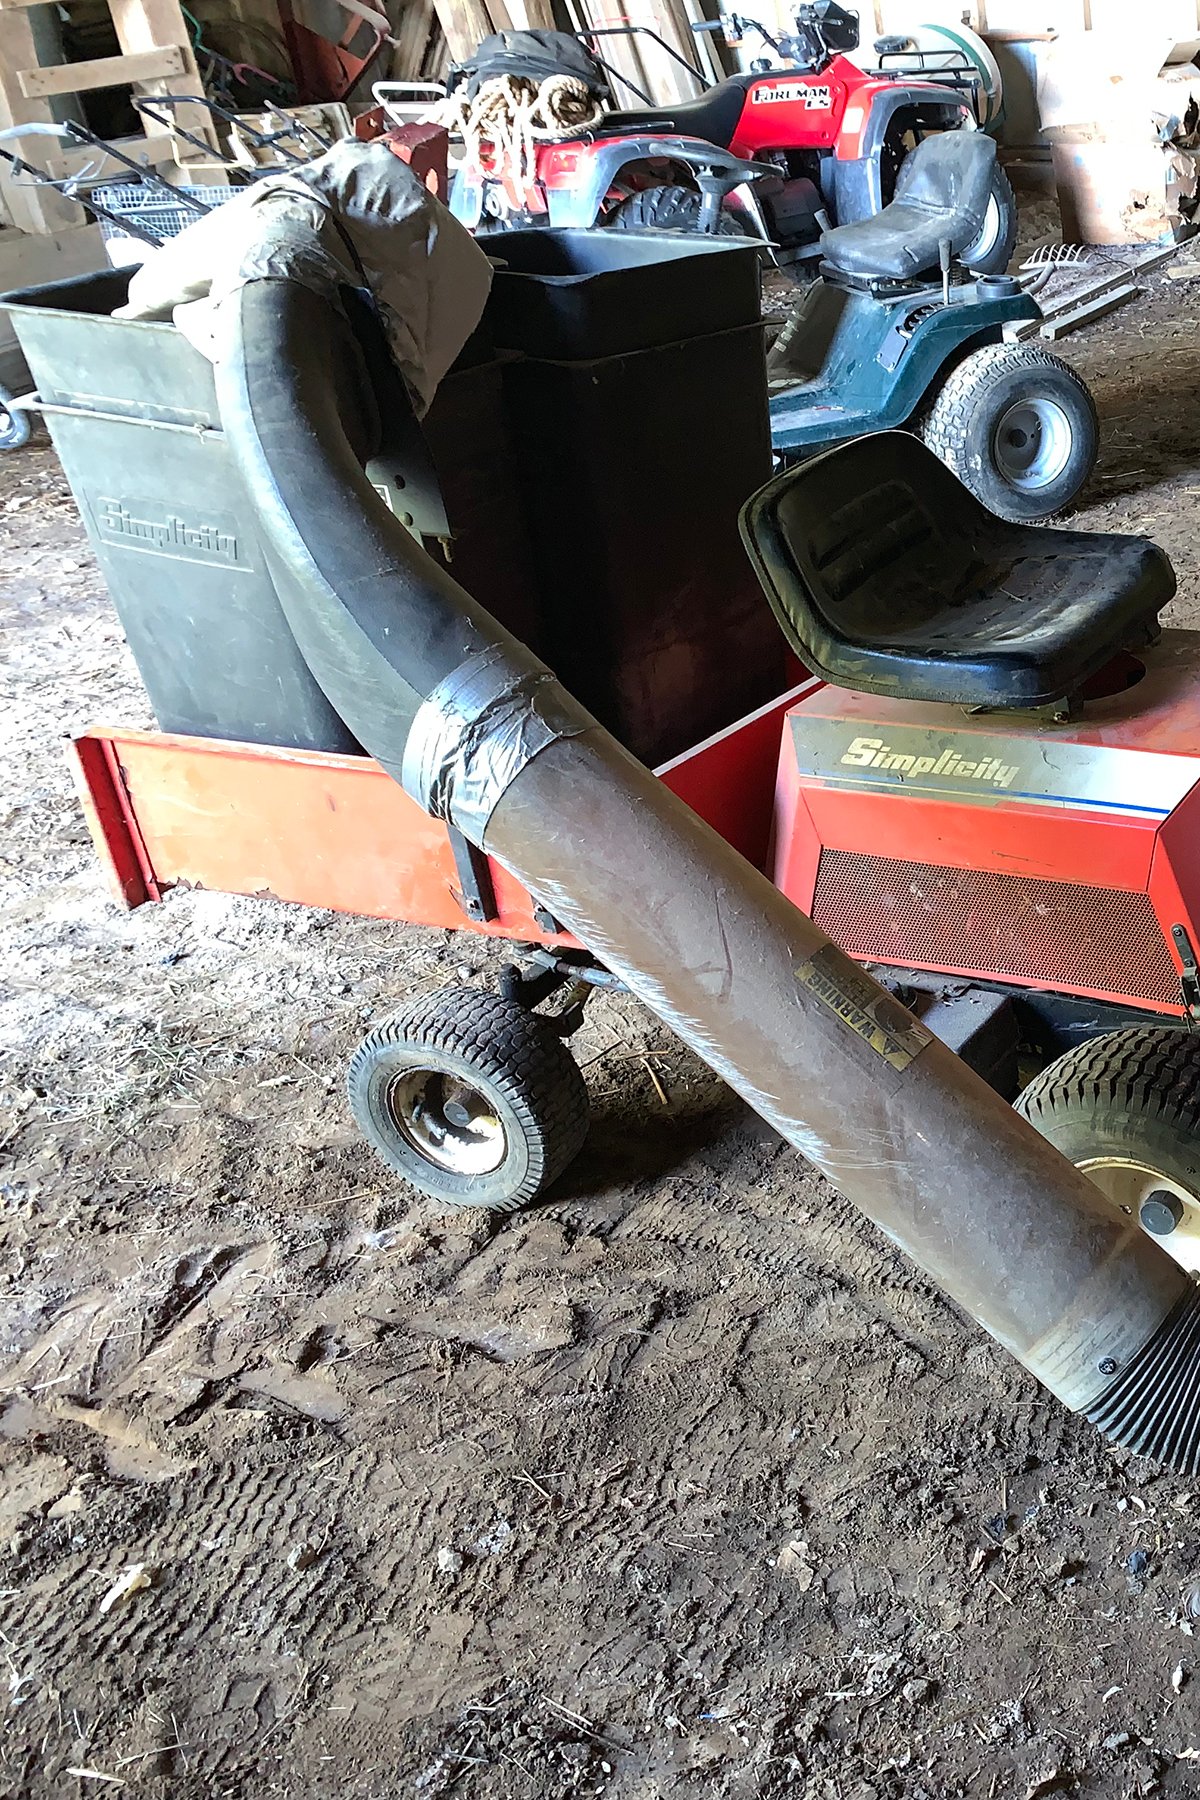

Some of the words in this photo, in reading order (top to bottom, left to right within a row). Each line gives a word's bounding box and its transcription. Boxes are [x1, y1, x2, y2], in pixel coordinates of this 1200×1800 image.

[101, 497, 237, 560] Simplicity
[841, 737, 1020, 788] Simplicity
[807, 975, 876, 1039] WARNING
